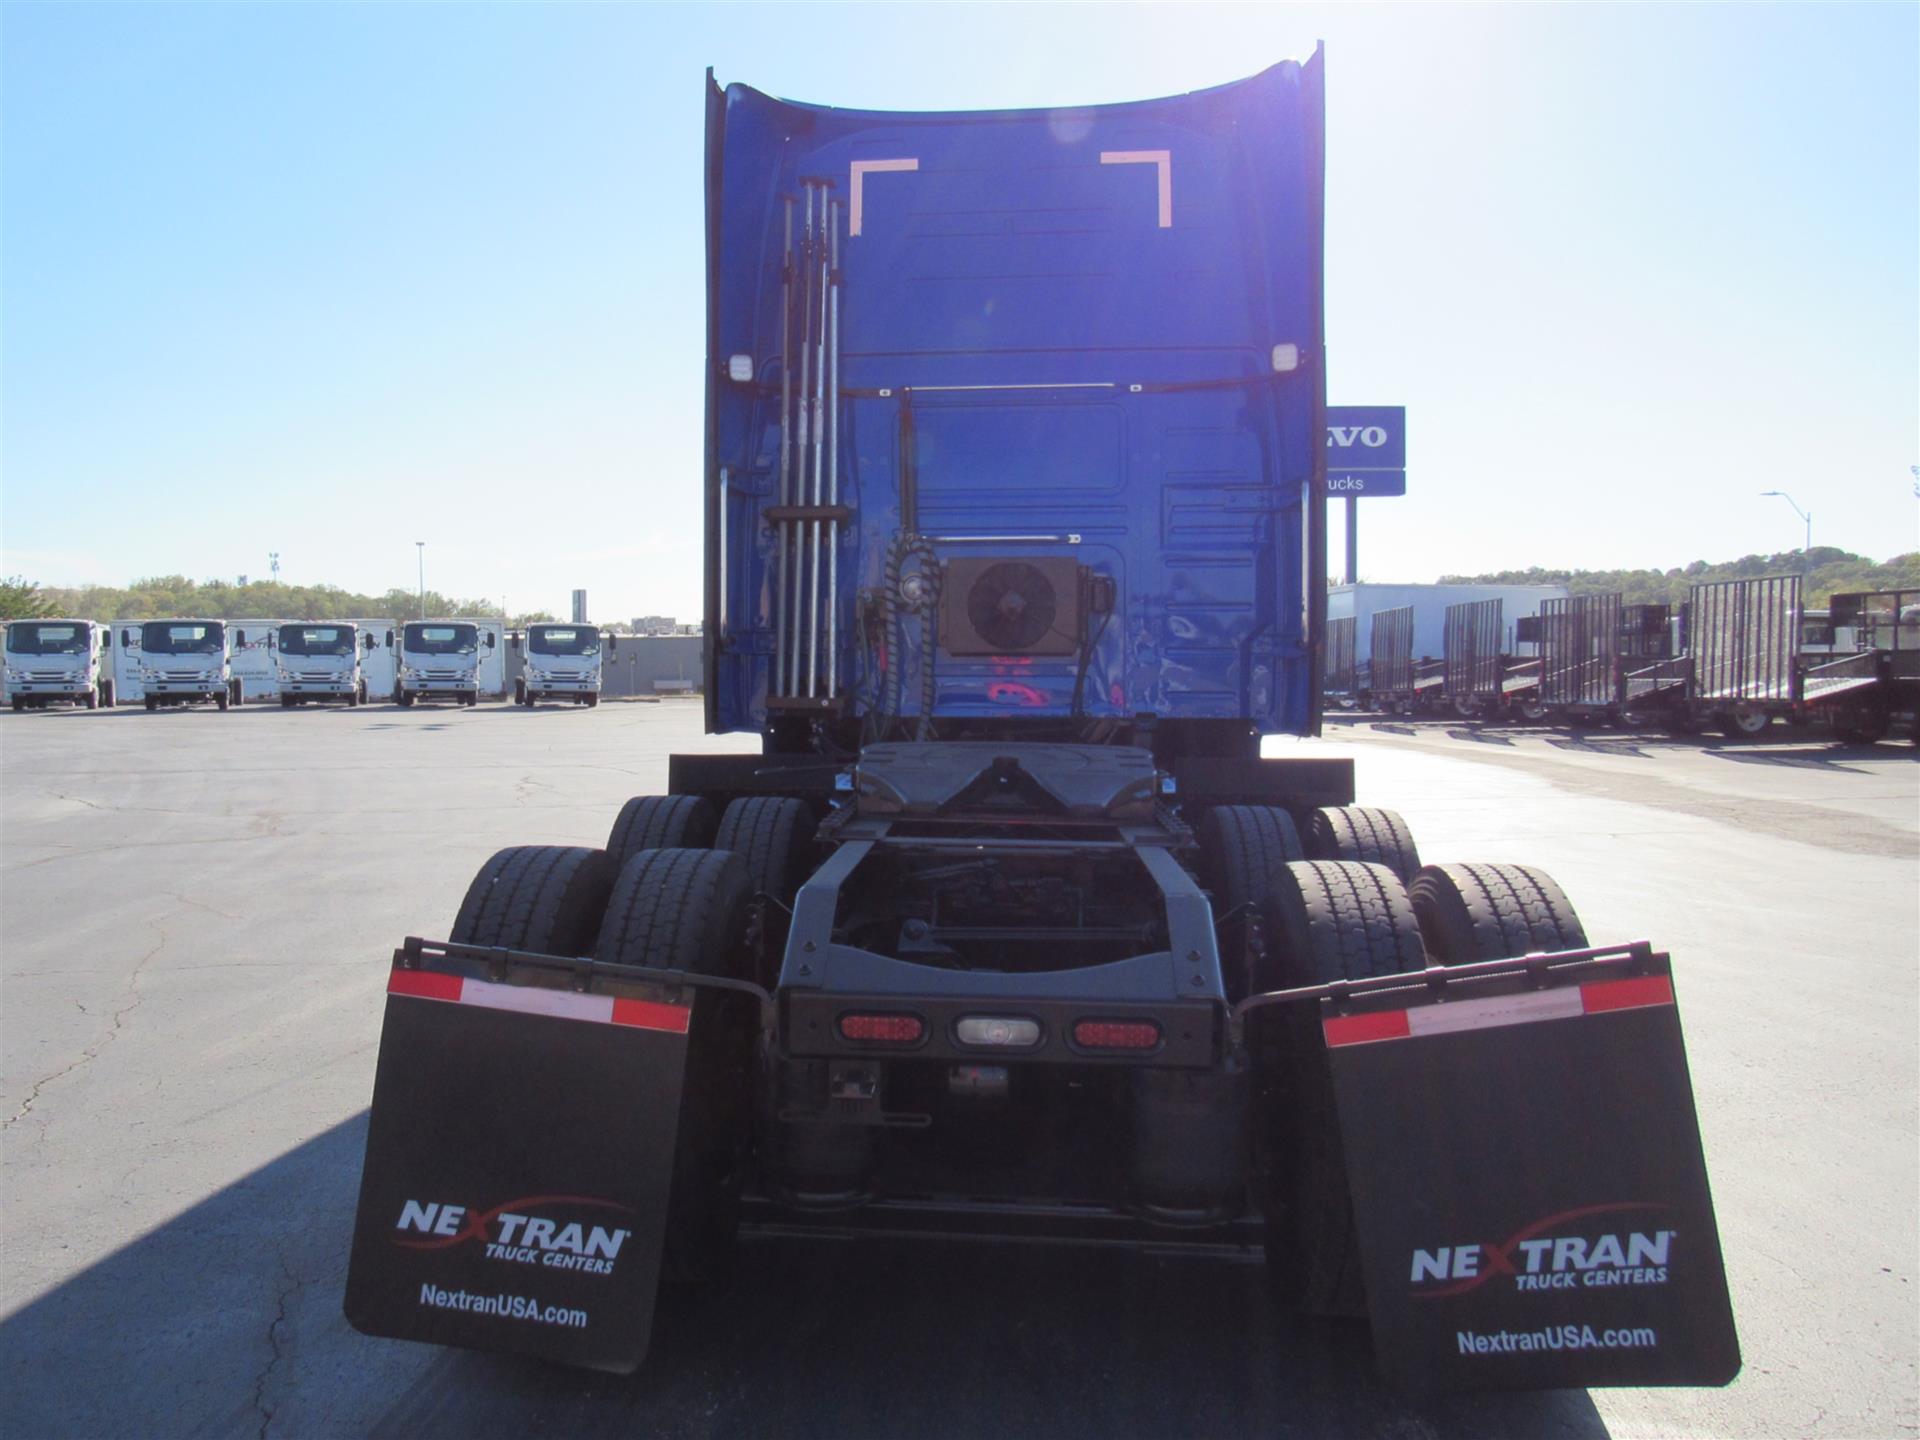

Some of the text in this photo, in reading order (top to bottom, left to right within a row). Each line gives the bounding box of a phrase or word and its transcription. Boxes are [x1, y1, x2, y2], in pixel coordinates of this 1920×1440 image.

[1326, 426, 1387, 448] VO
[396, 1199, 626, 1260] NEXTRAN
[486, 1243, 615, 1275] TRUCK CENTERS
[1411, 1230, 1671, 1282] NEXTRAN
[1516, 1267, 1668, 1291] TRUCK CENTERS
[420, 1283, 588, 1328] NextranUSA.com
[1457, 1324, 1656, 1354] NextranUSA.com
